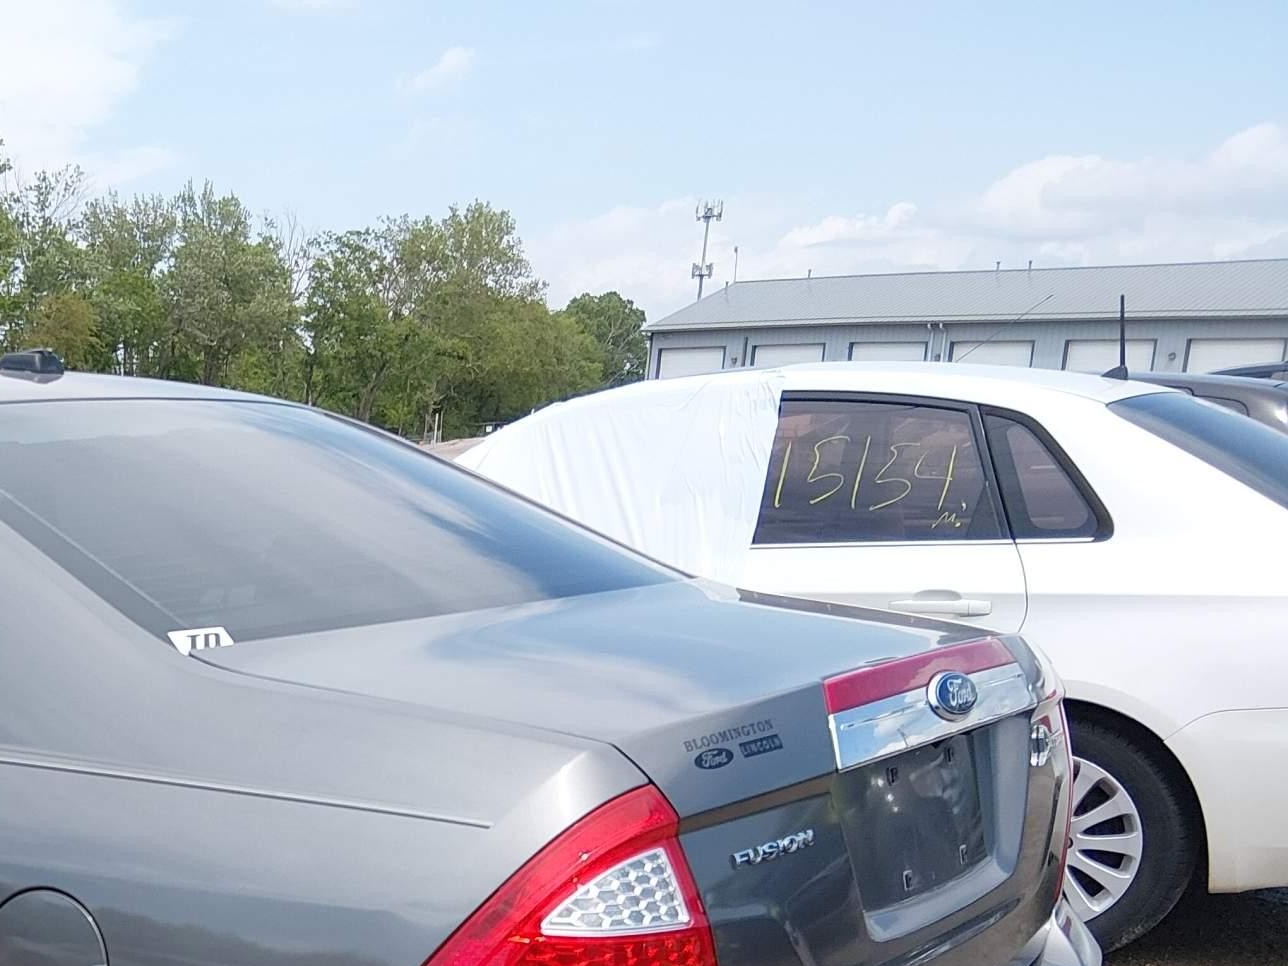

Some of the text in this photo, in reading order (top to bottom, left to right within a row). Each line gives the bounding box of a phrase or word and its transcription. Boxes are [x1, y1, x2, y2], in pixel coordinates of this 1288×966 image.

[774, 435, 957, 511] 15154
[946, 678, 976, 707] Ford
[682, 719, 774, 753] BLOOMINGTON
[701, 750, 729, 768] Ford
[732, 829, 815, 865] FUSION
